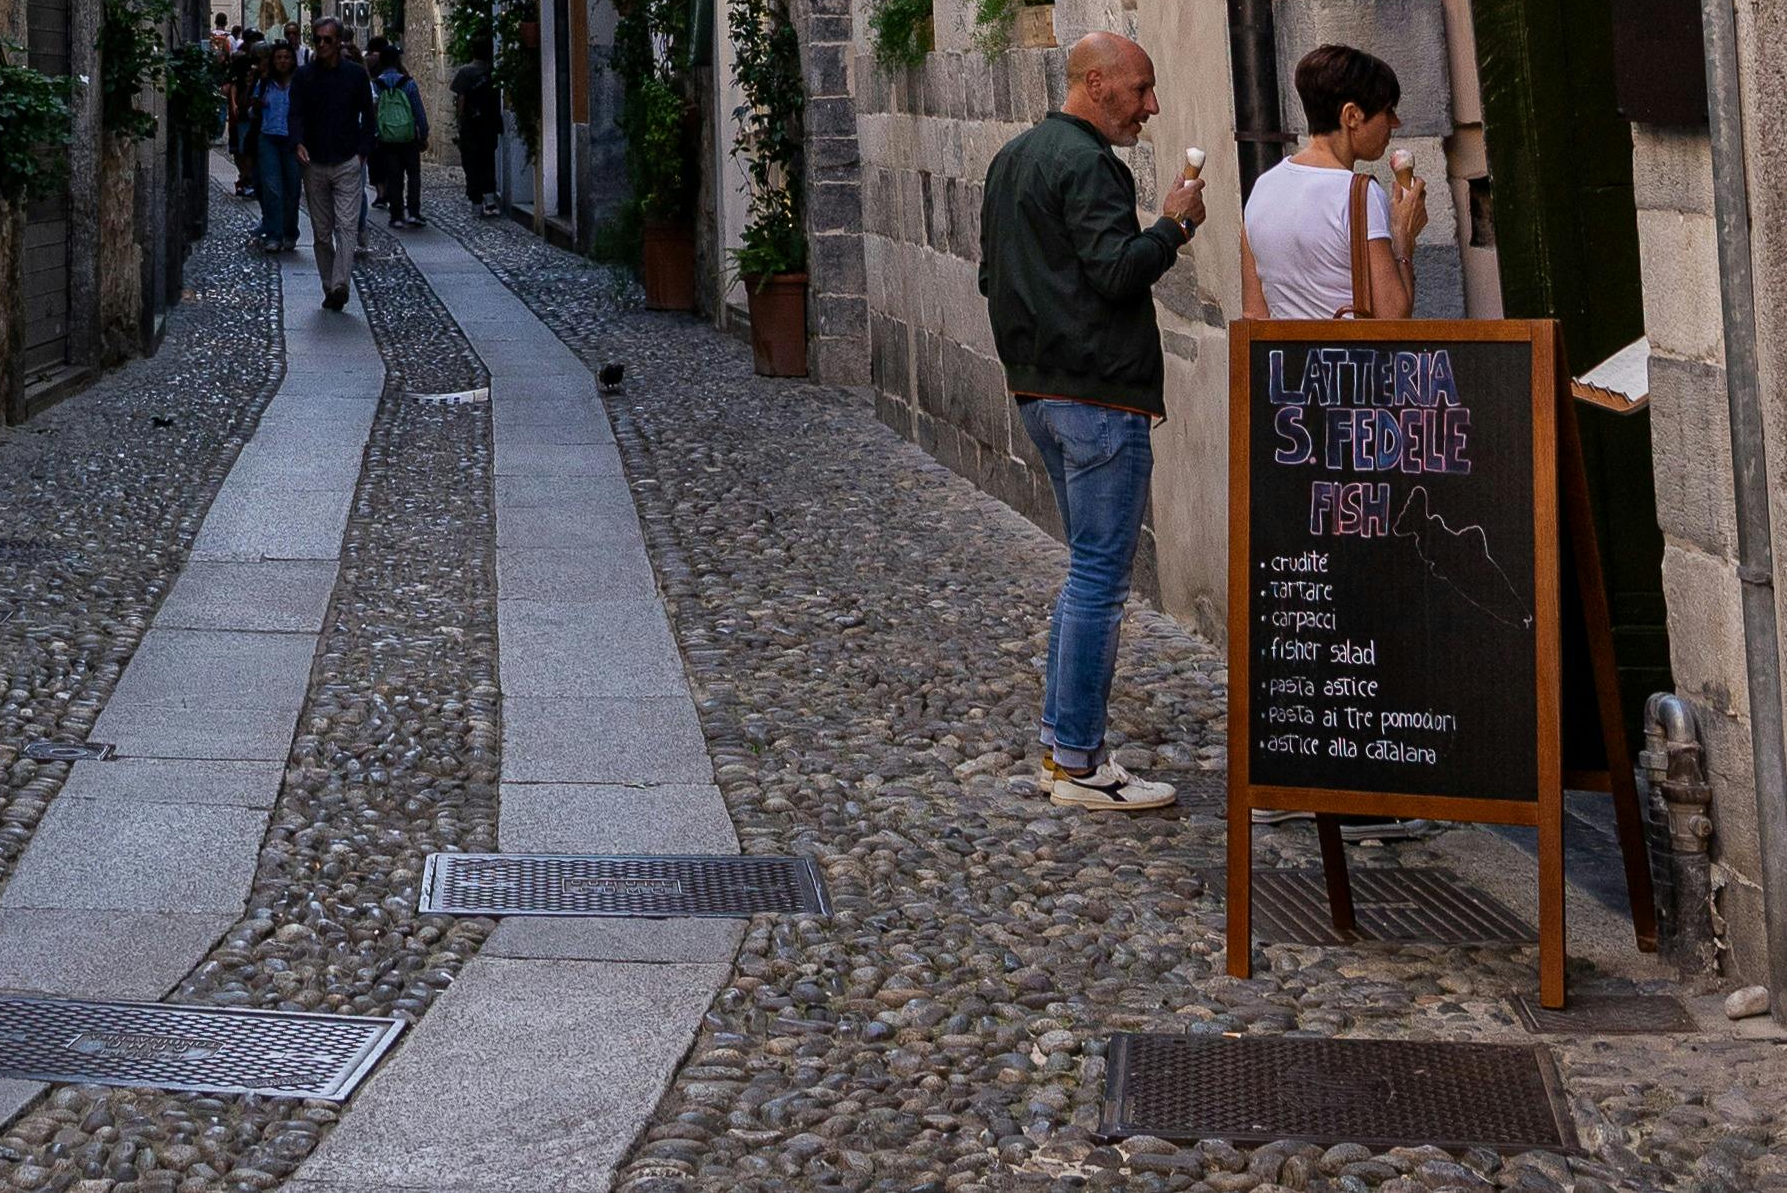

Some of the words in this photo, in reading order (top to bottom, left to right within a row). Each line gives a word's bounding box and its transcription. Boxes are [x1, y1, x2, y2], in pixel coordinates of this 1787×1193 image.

[1268, 348, 1462, 406] LATTERIA
[1274, 406, 1318, 465] S.
[1325, 407, 1472, 474] FEDELE
[1310, 481, 1391, 538] FISH
[1270, 550, 1329, 573] crudité
[1269, 581, 1333, 601] tartare
[1271, 608, 1336, 633] carpacci
[1270, 636, 1322, 661] fisher
[1329, 639, 1376, 666] salad
[1269, 676, 1315, 696] pasta
[1323, 676, 1379, 697] astice
[1268, 705, 1315, 724] pasta
[1322, 707, 1338, 728] ai
[1344, 708, 1374, 730] tre
[1380, 708, 1457, 735] pomodori
[1267, 733, 1320, 756] astice
[1328, 737, 1358, 758] alla
[1365, 740, 1437, 765] catalana
